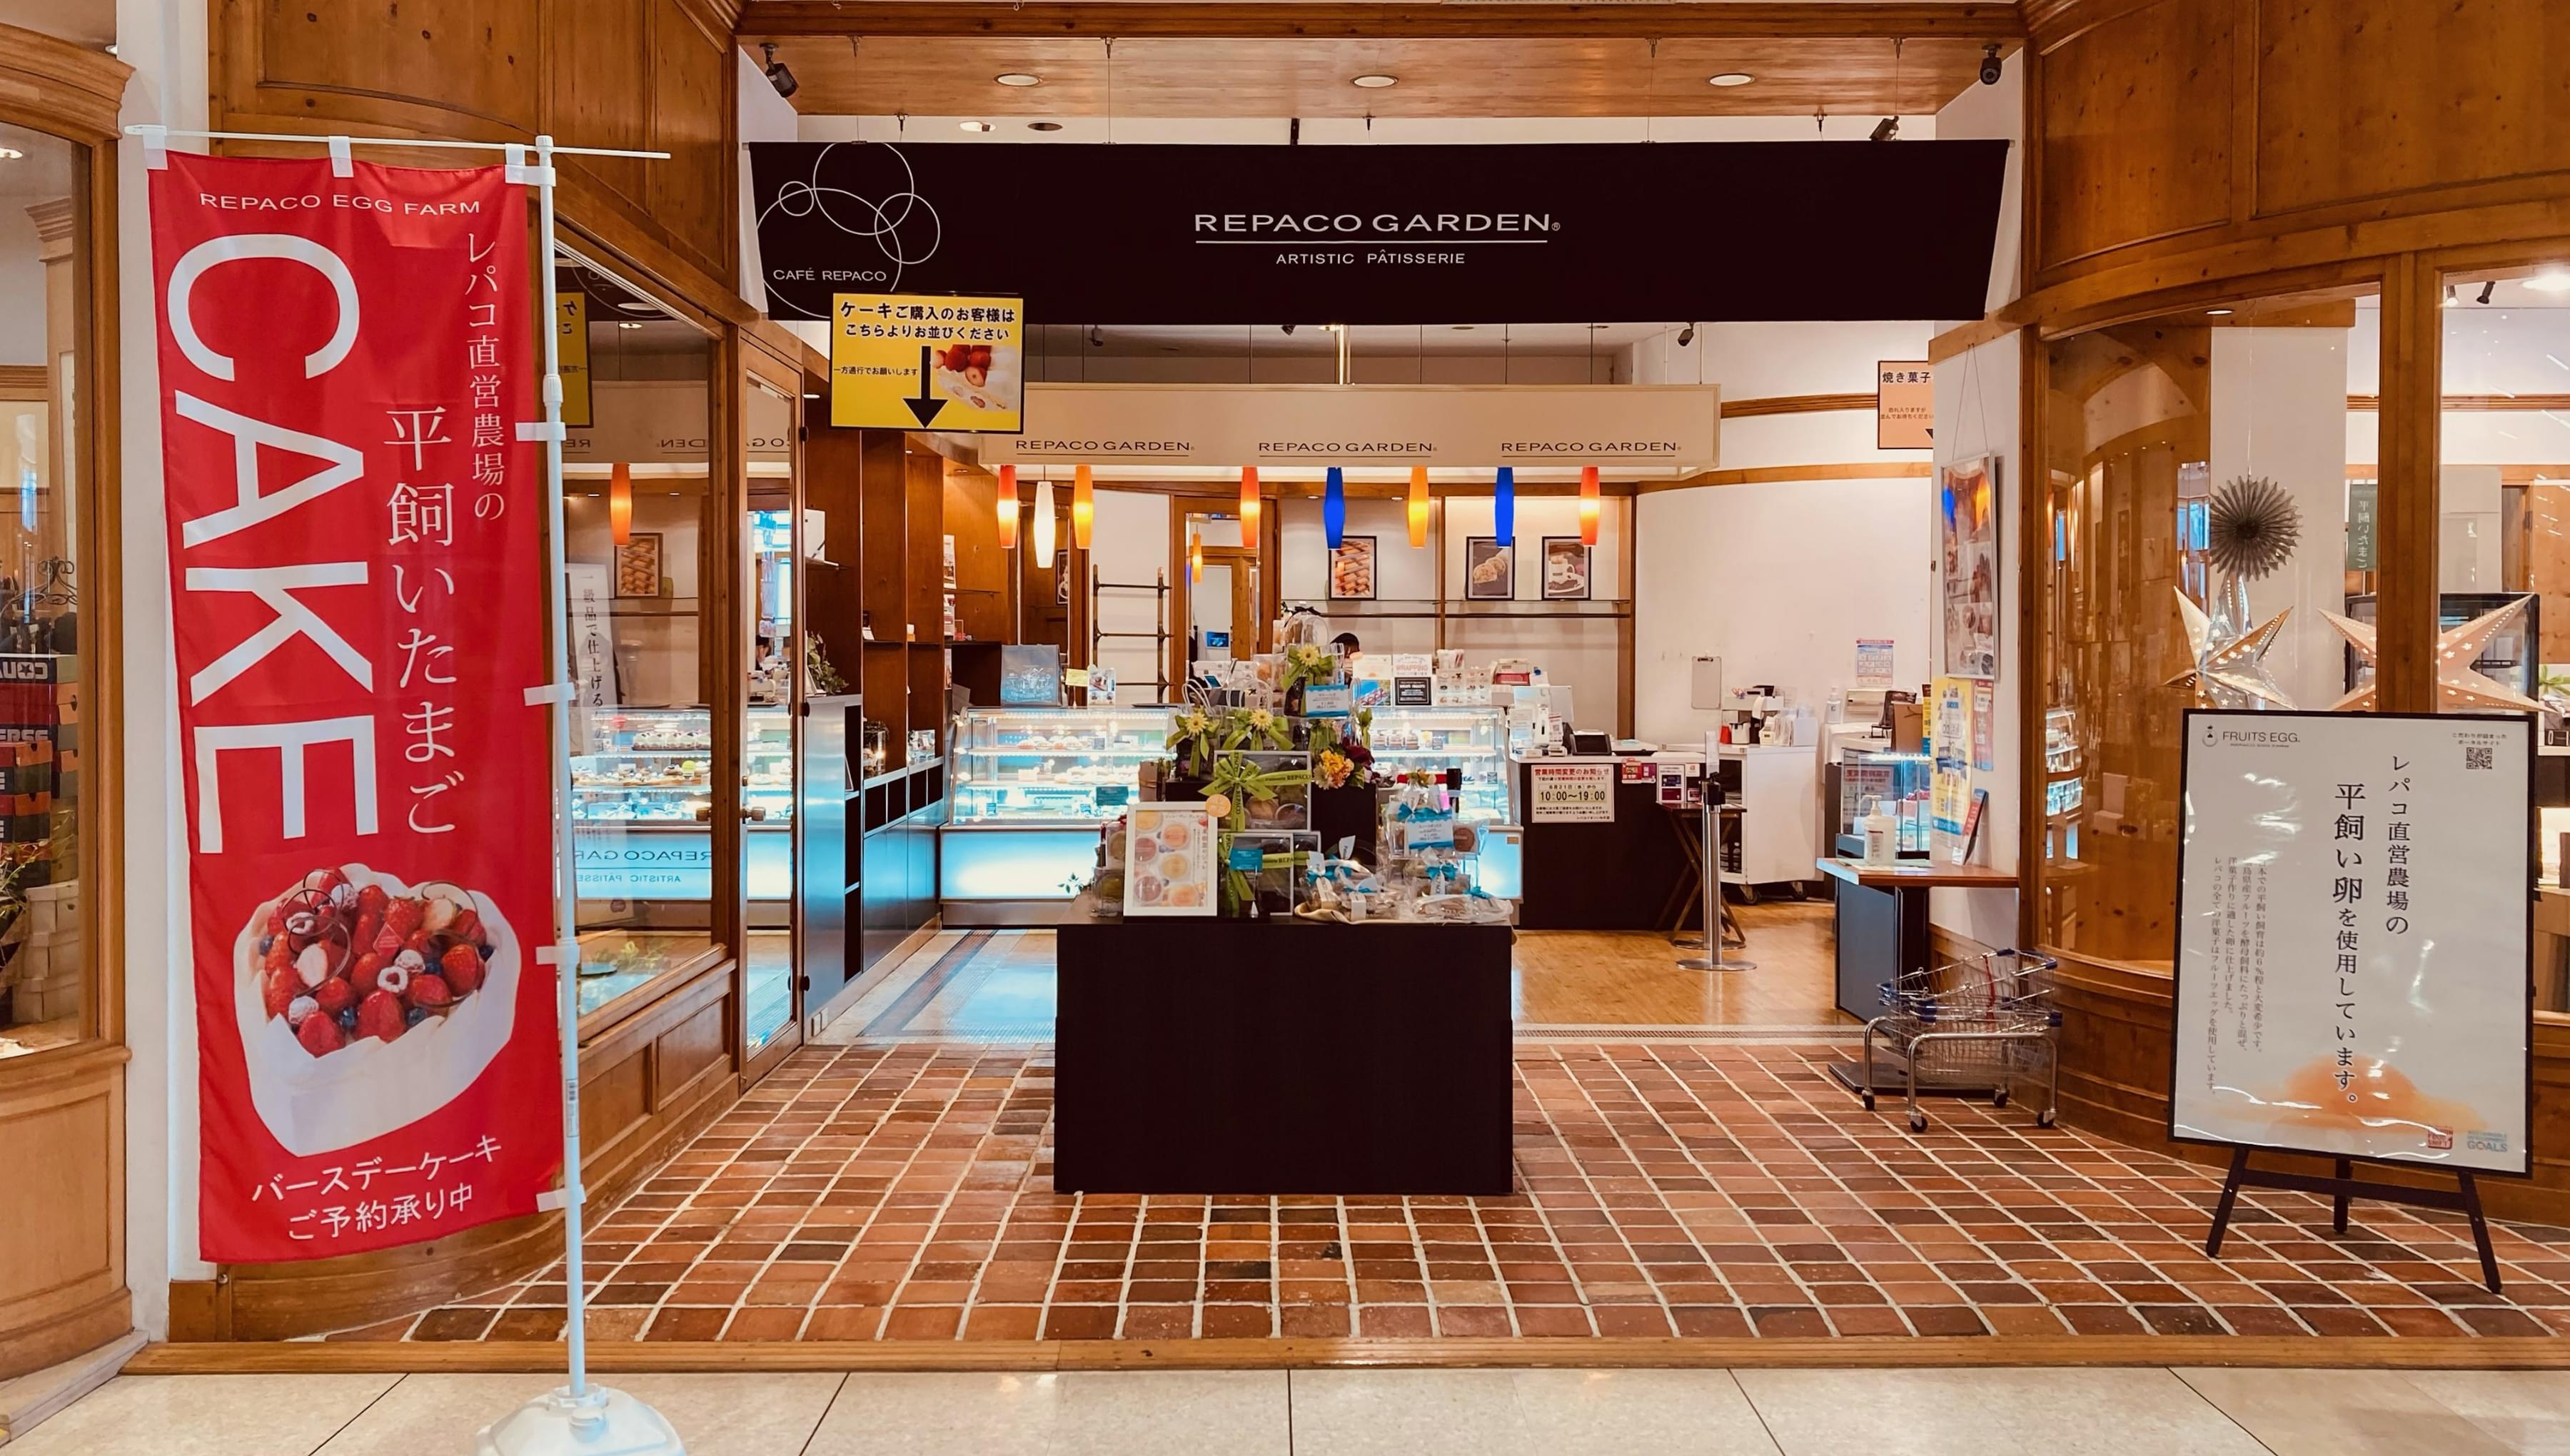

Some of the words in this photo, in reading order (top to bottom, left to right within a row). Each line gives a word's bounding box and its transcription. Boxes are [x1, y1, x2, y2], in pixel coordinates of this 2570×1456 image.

[200, 193, 321, 211] REPACO
[333, 194, 393, 213] EGG
[404, 201, 480, 216] FARM
[1195, 214, 1362, 232] REPACO
[1276, 253, 1354, 265] ARTISTIC
[1367, 249, 1465, 264] PÂTISSERIE
[773, 267, 815, 280] CAFÉ
[822, 271, 887, 282] REPACO
[840, 301, 1015, 323] ケーキご購入のお客様は
[846, 323, 1009, 340] こちらよりお並びください
[465, 232, 505, 521] レパコ直営農場の
[834, 366, 918, 376] 一方通行でお願いします
[1882, 371, 1931, 383] 焼き菓子
[1017, 440, 1099, 450] REPACO
[1259, 443, 1341, 452] REPACO
[1501, 442, 1584, 452] REPACO
[167, 233, 378, 854] CAKE
[383, 406, 464, 834] 平飼いたまご
[2222, 731, 2267, 742] FRUITS
[2386, 755, 2411, 935] レパコ直営農場の
[2332, 783, 2366, 1103] 平飼い卵を使用しています。
[2467, 1141, 2508, 1153] GOALS
[251, 1133, 502, 1203] バースデーケーキ
[288, 1182, 473, 1240] ご予約承り中
